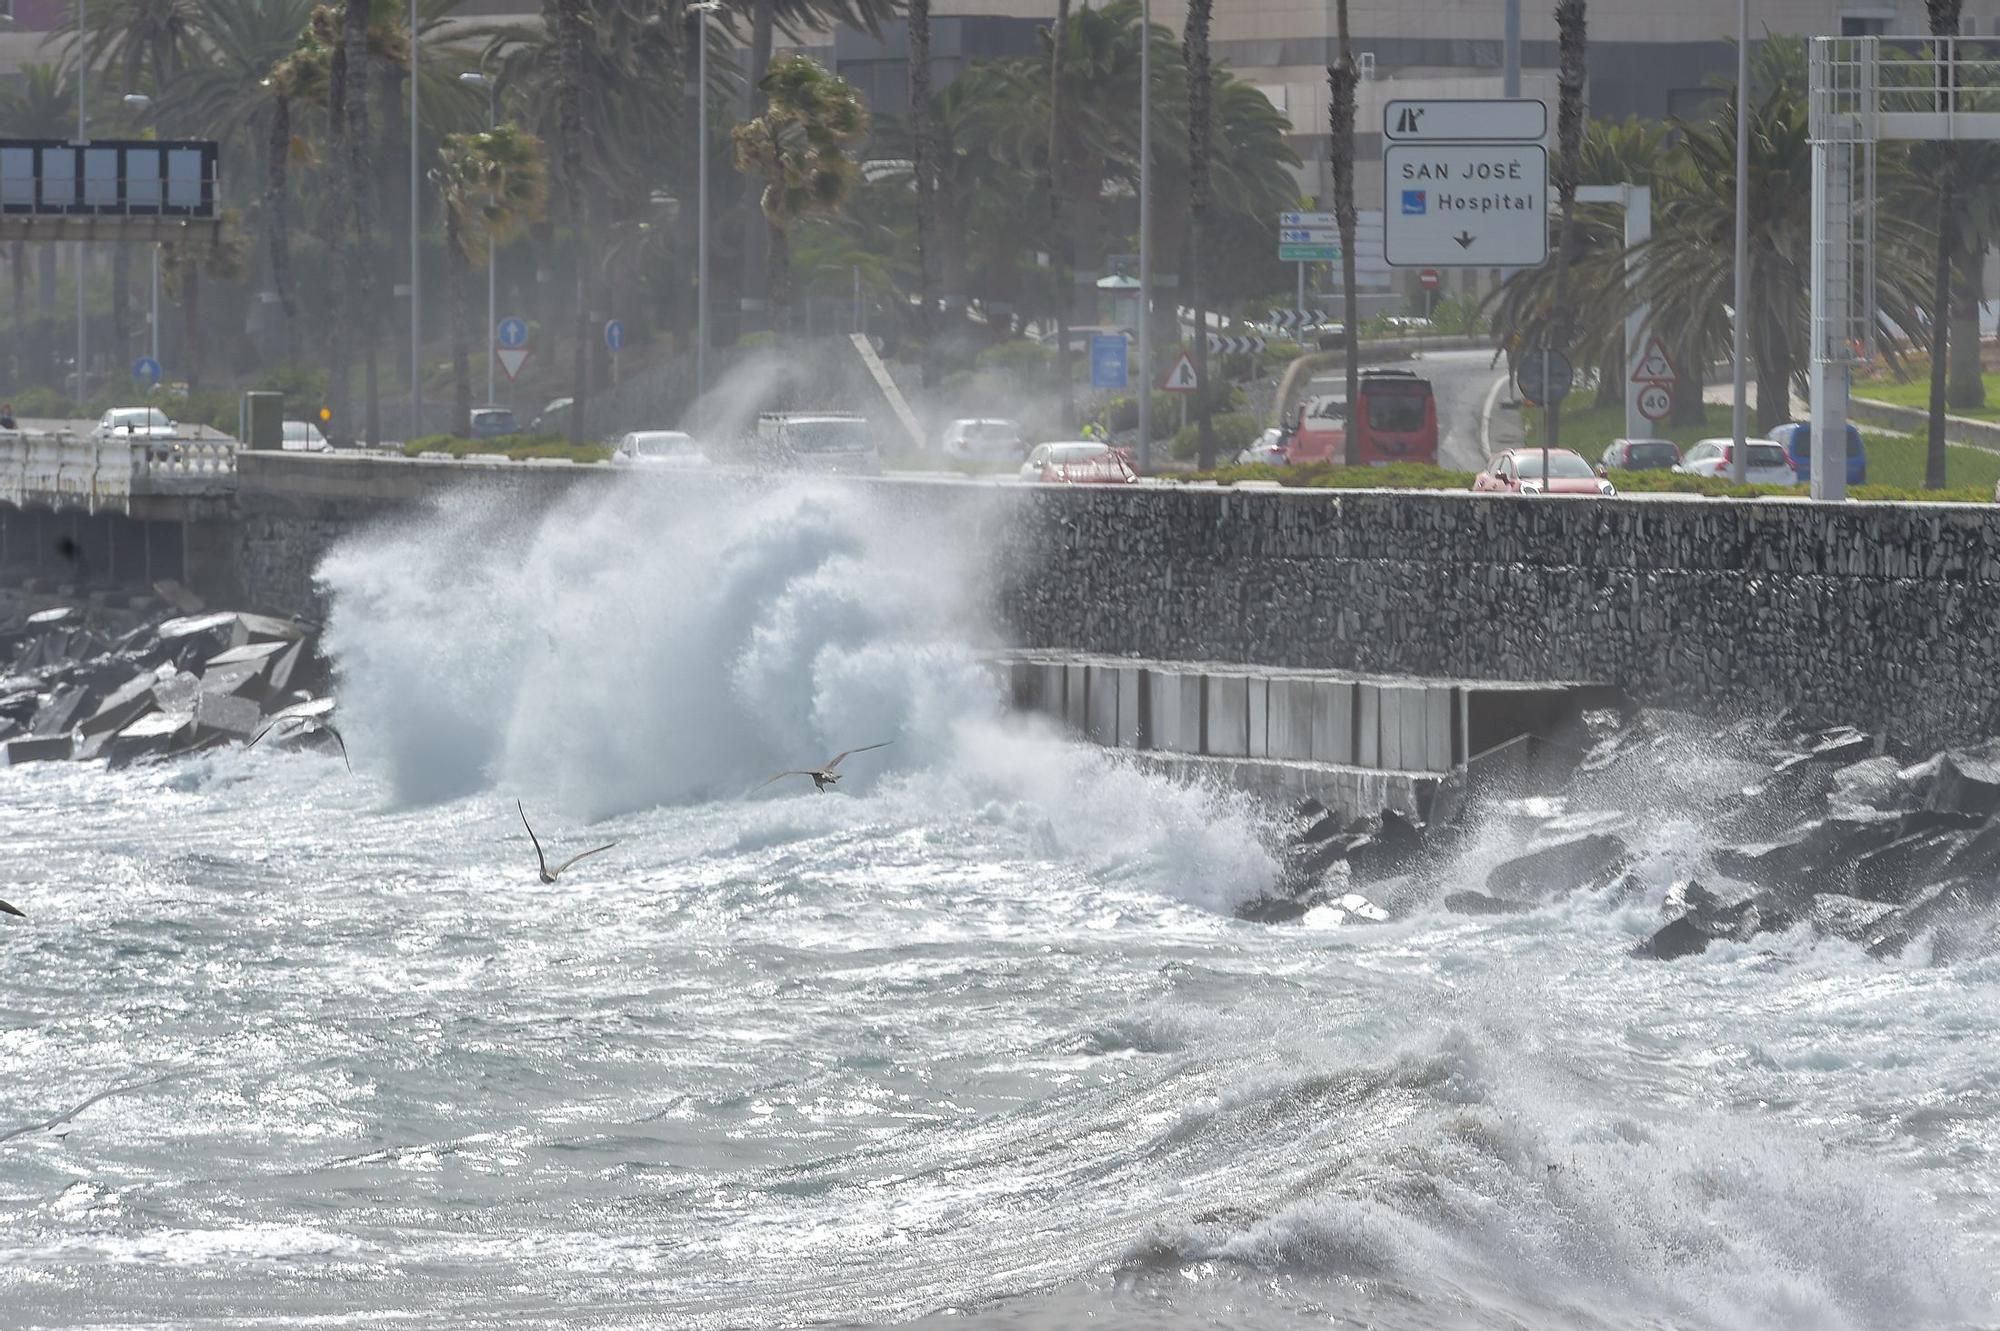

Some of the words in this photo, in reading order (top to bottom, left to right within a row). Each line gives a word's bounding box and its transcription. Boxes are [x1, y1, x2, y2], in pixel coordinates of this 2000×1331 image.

[1402, 163, 1448, 179] SAN
[1462, 159, 1521, 179] JOSÉ
[1438, 193, 1532, 213] Hospital
[1645, 395, 1668, 409] 40
